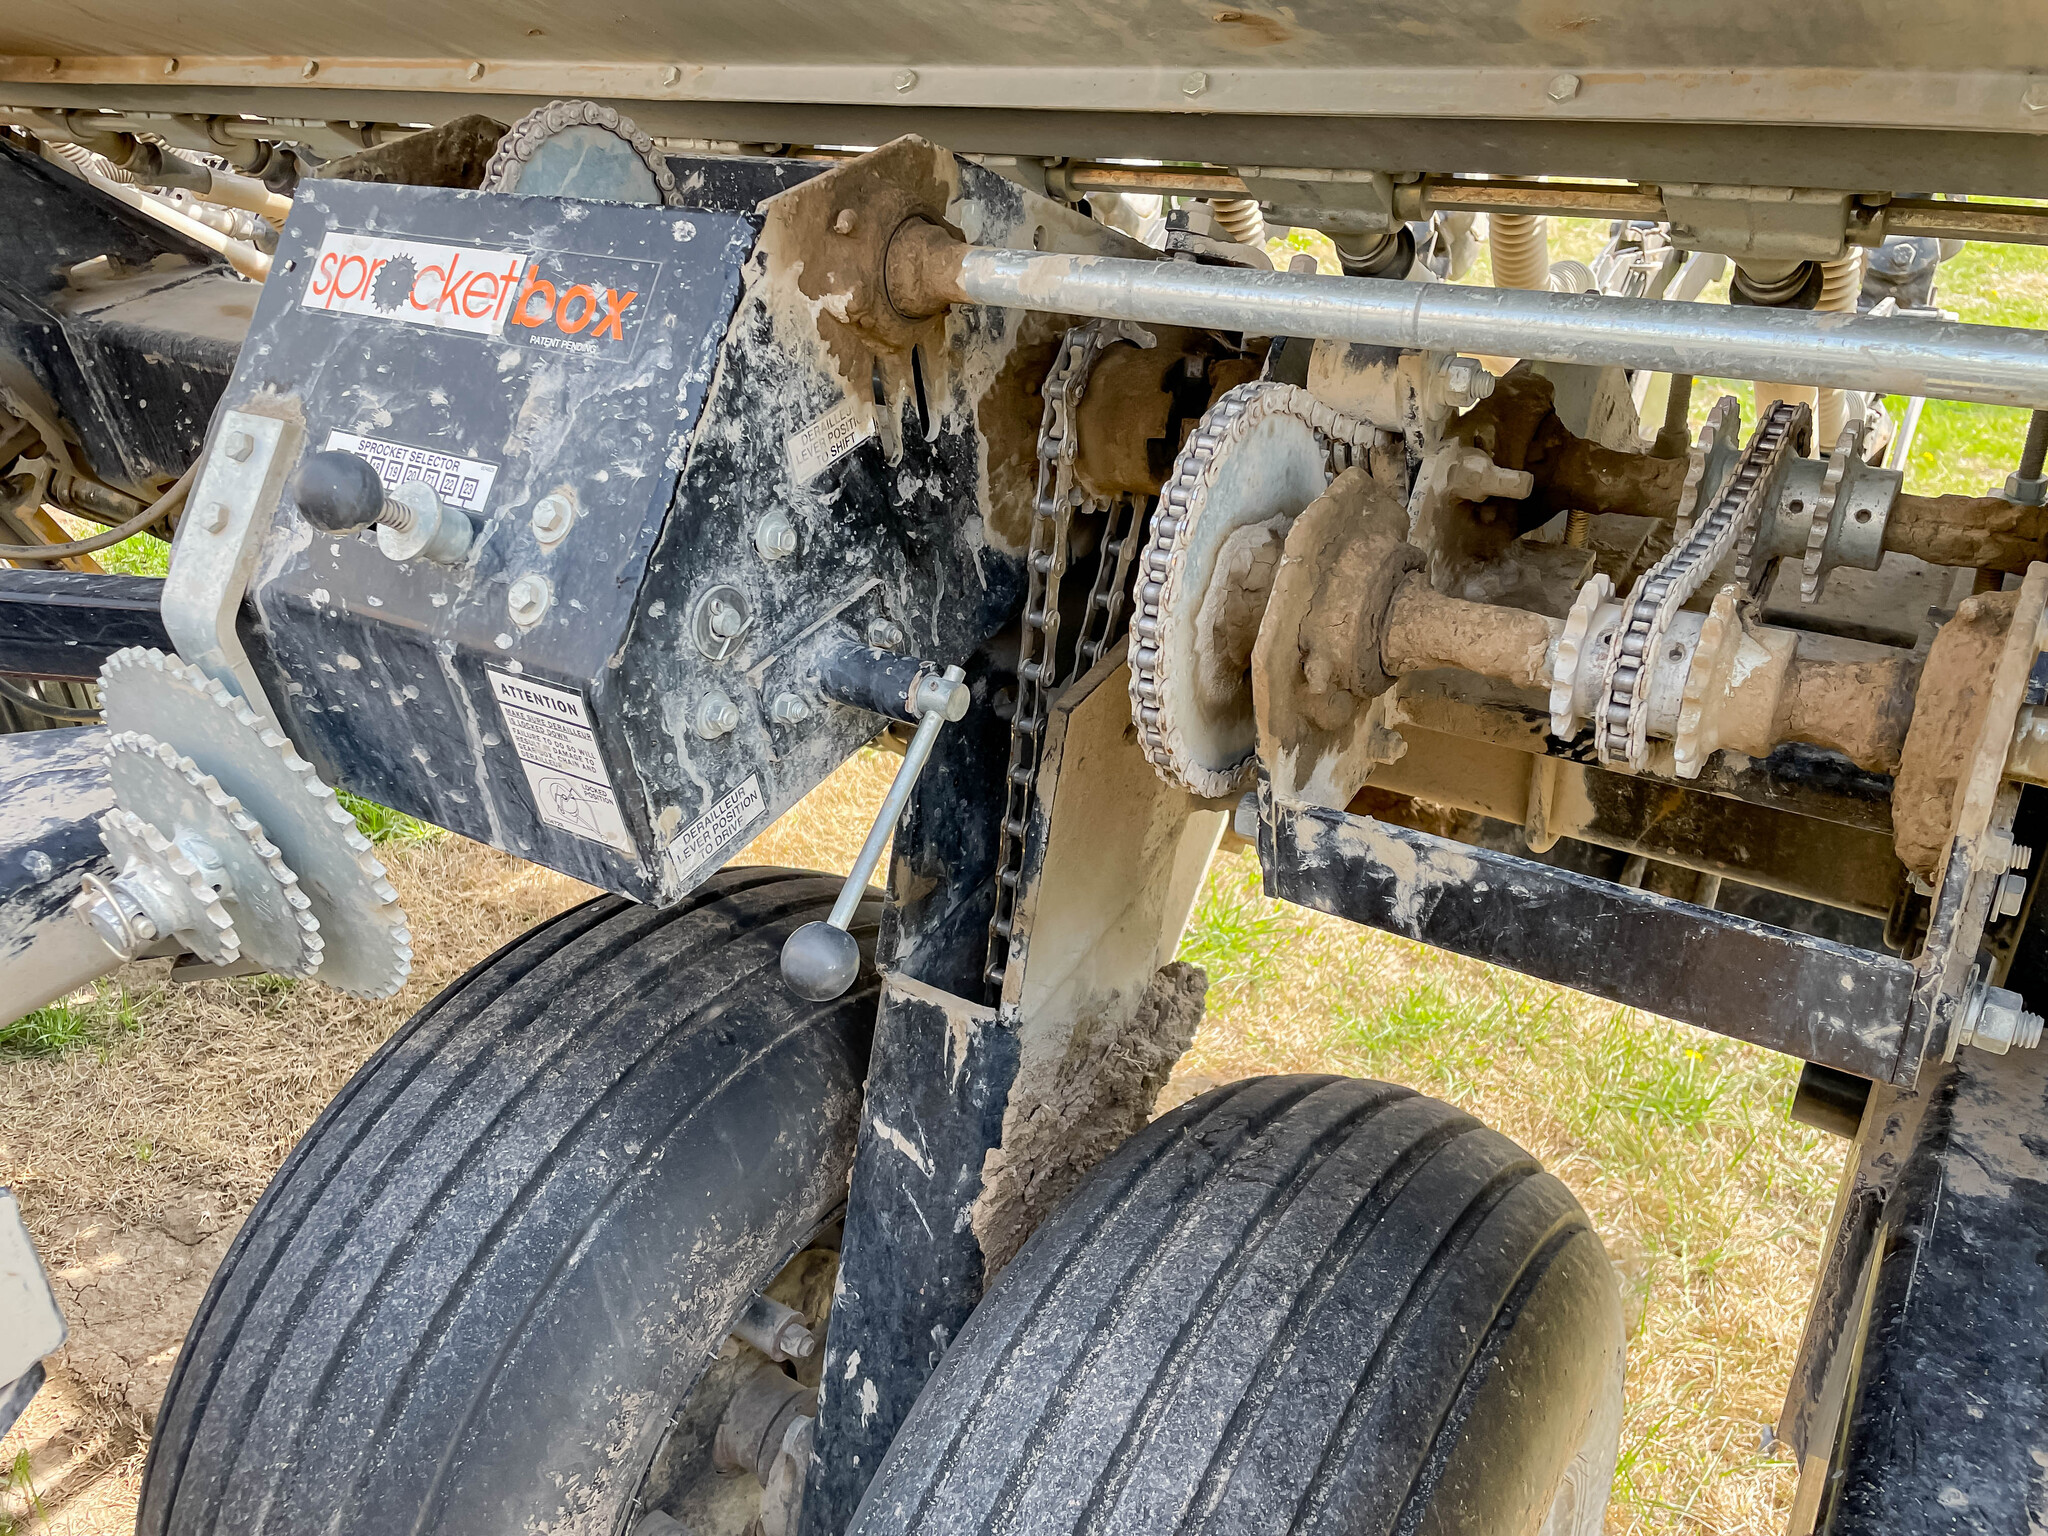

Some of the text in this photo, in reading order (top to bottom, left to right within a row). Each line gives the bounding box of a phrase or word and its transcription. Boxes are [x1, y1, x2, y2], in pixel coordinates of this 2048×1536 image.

[529, 335, 597, 354] PATENT PENDING
[358, 440, 461, 472] SPROCKET SELECTOR
[796, 416, 861, 465] LEVER POSITI
[817, 432, 856, 465] TO SHIFT
[389, 466, 398, 477] 19
[407, 470, 417, 481] 20
[426, 474, 434, 484] 21
[443, 479, 454, 490] 22
[463, 484, 474, 495] 23
[501, 682, 579, 717] ATTENTION
[504, 707, 592, 740] MAKE SURE DERAILLEUR
[516, 719, 545, 733] LOCKED
[512, 727, 596, 760] FAILURE TO DO SO WILL
[515, 735, 541, 748] RESULT
[552, 747, 583, 762] DAMAGE
[584, 757, 595, 766] TO
[557, 755, 580, 768] CHAIN
[581, 763, 597, 773] AND
[581, 784, 608, 797] LOCKED
[584, 791, 615, 806] POSITION
[677, 790, 758, 865] LEVER POSITION
[682, 787, 746, 845] DERAILLEUR
[698, 844, 714, 859] TO
